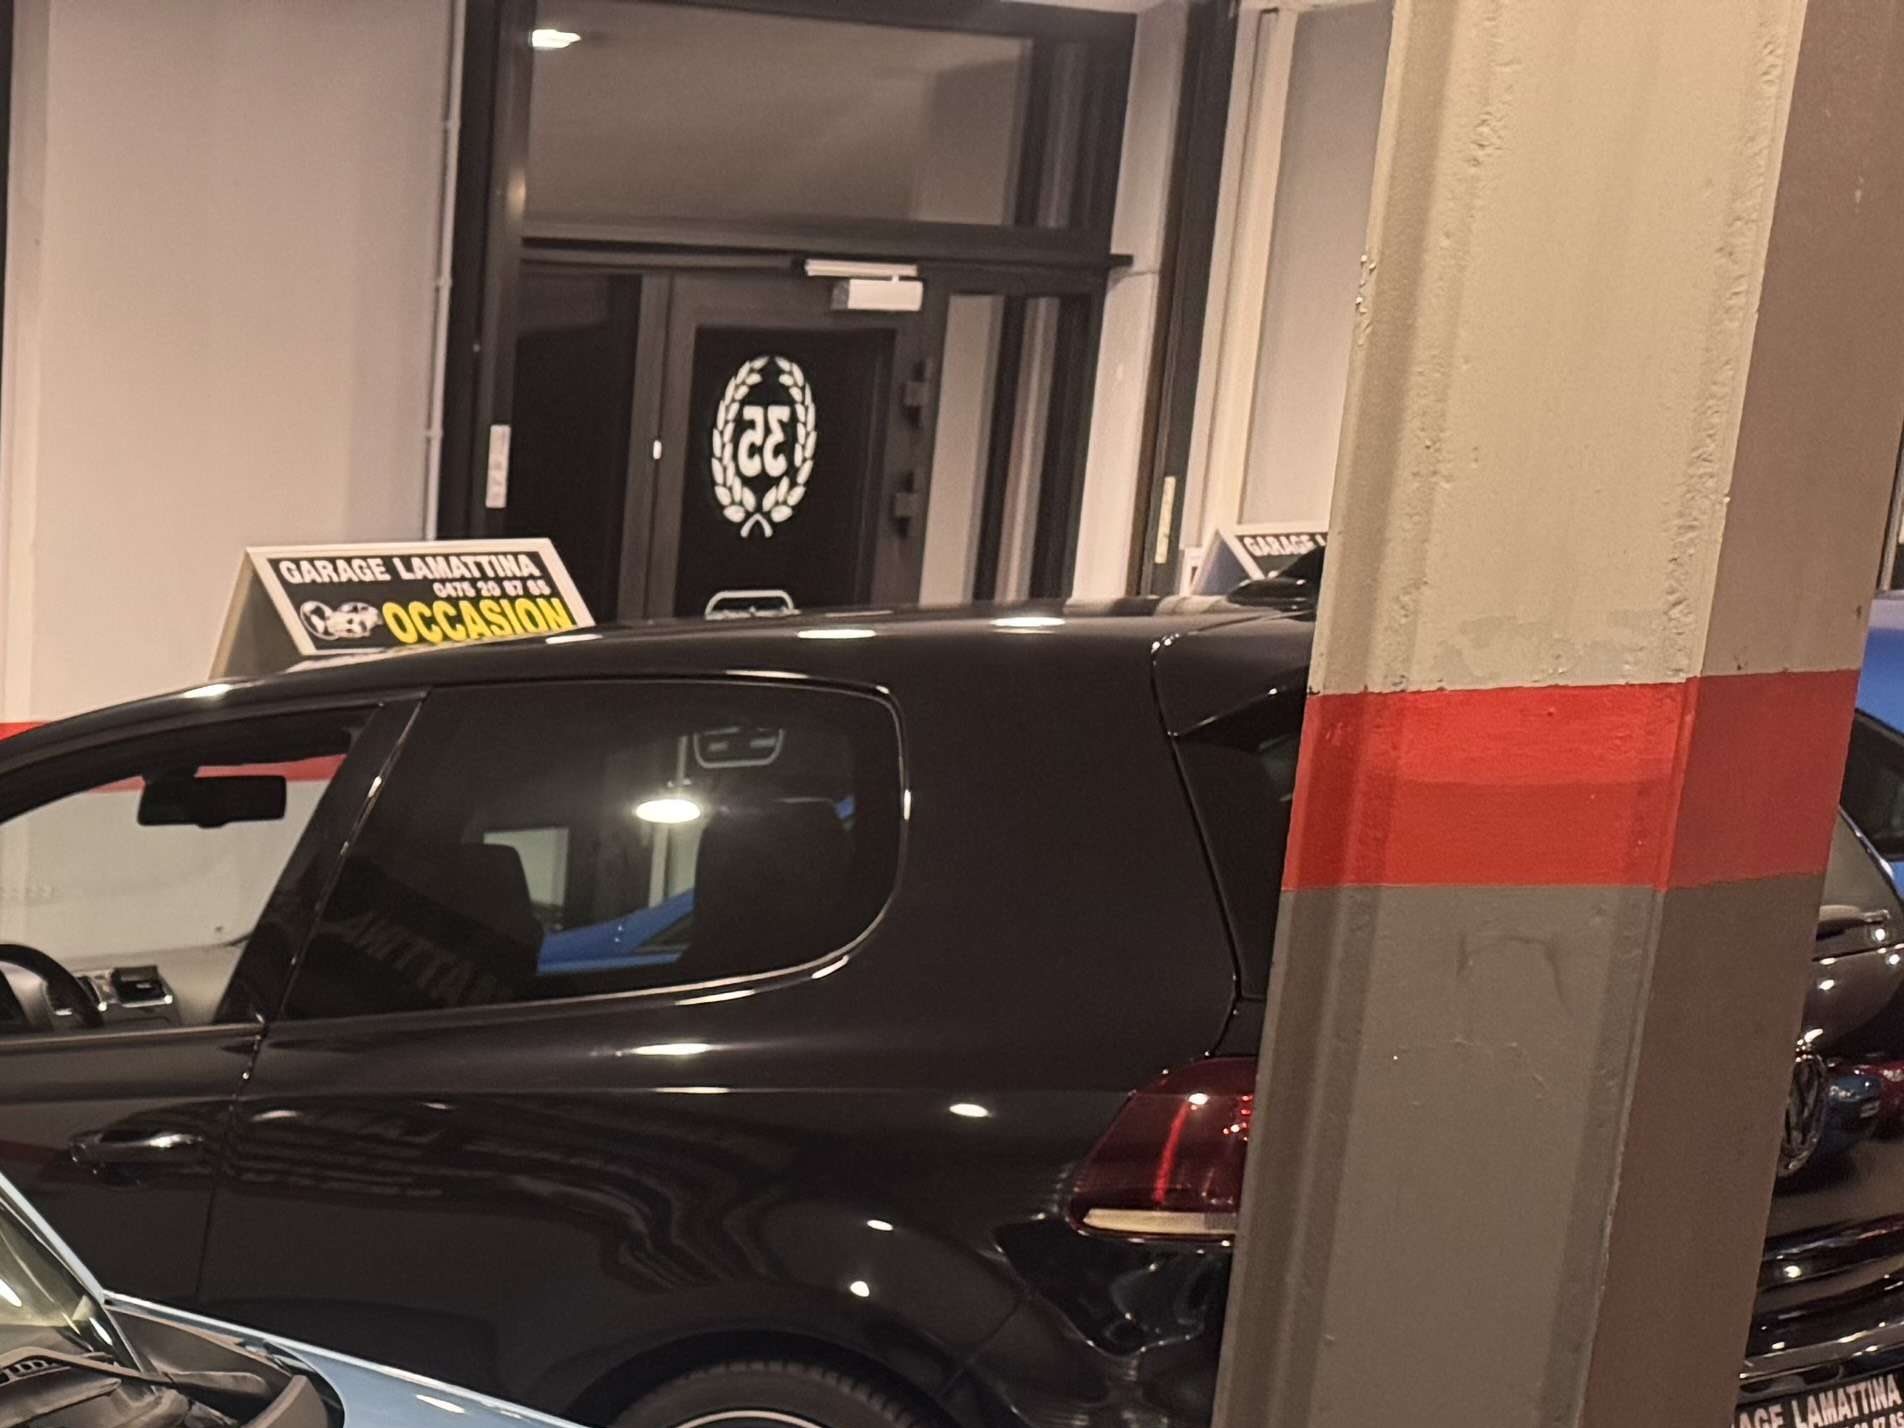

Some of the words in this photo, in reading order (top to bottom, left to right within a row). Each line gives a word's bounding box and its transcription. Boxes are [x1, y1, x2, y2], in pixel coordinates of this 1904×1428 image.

[278, 557, 391, 584] GARAGE
[392, 554, 542, 581] LAMATTINA
[382, 596, 579, 645] OCCASION
